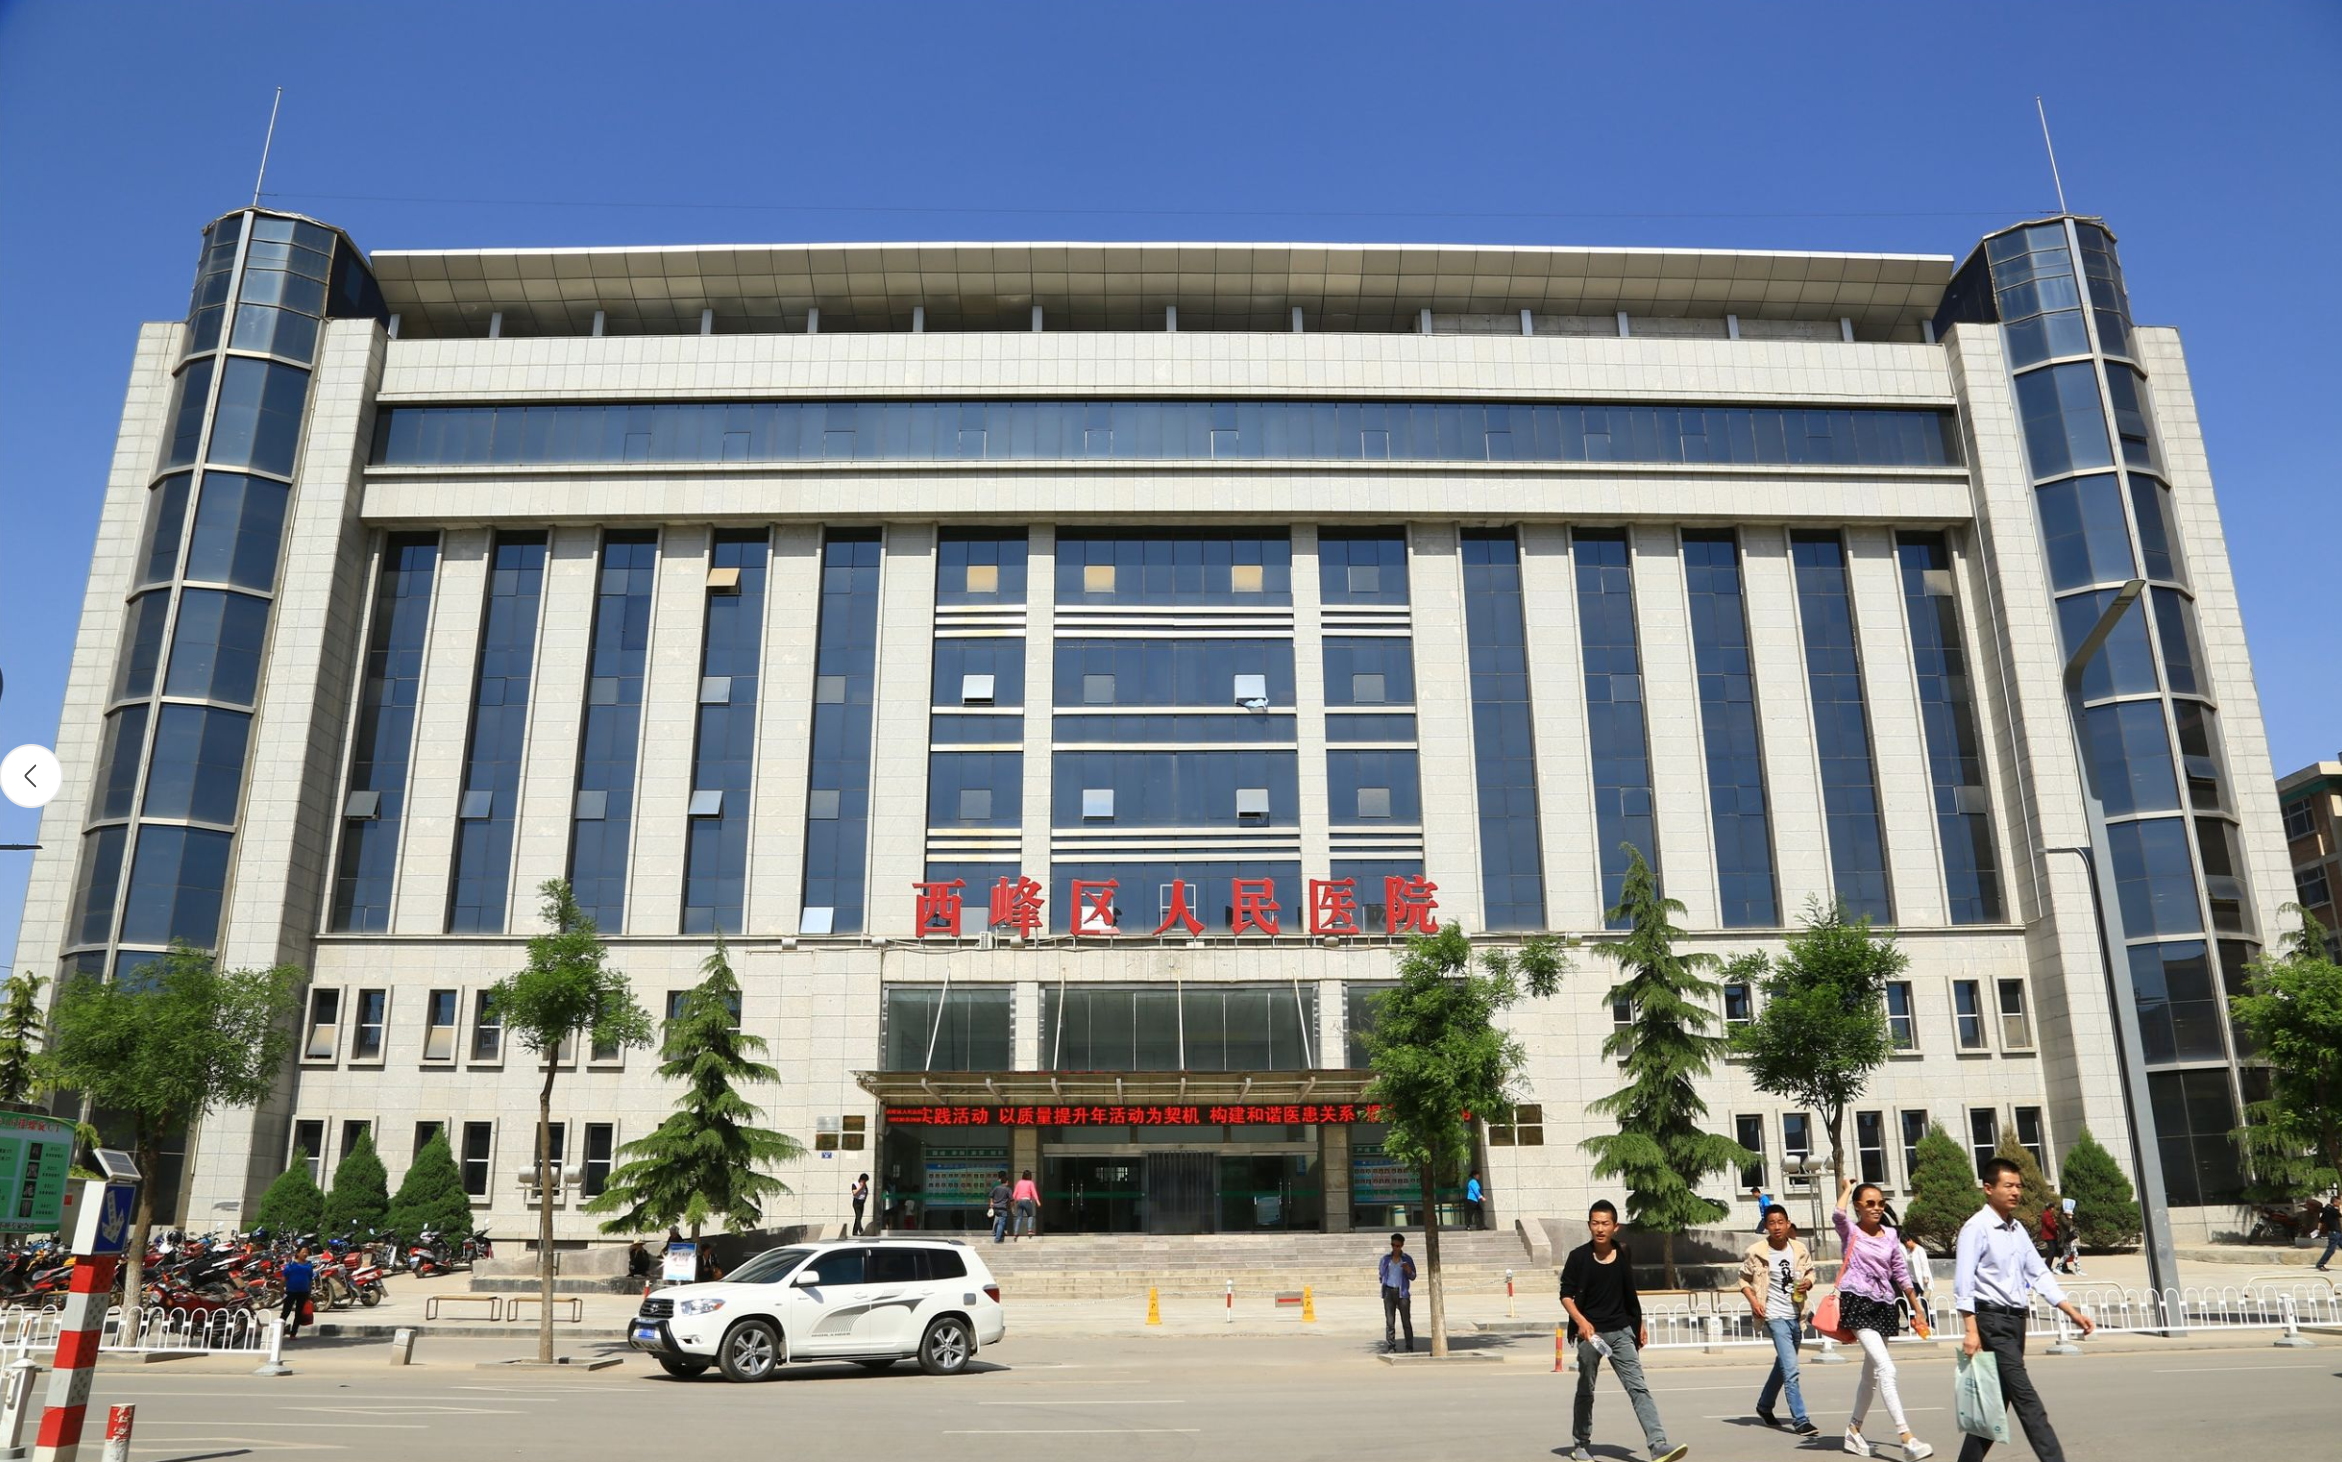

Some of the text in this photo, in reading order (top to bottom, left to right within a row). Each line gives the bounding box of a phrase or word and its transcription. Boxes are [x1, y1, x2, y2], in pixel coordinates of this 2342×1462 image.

[911, 874, 1439, 938] 西峰区人民医院
[998, 1105, 1201, 1125] 以质量提升年活动为契机
[1209, 1104, 1356, 1125] 构建和谐医患关系
